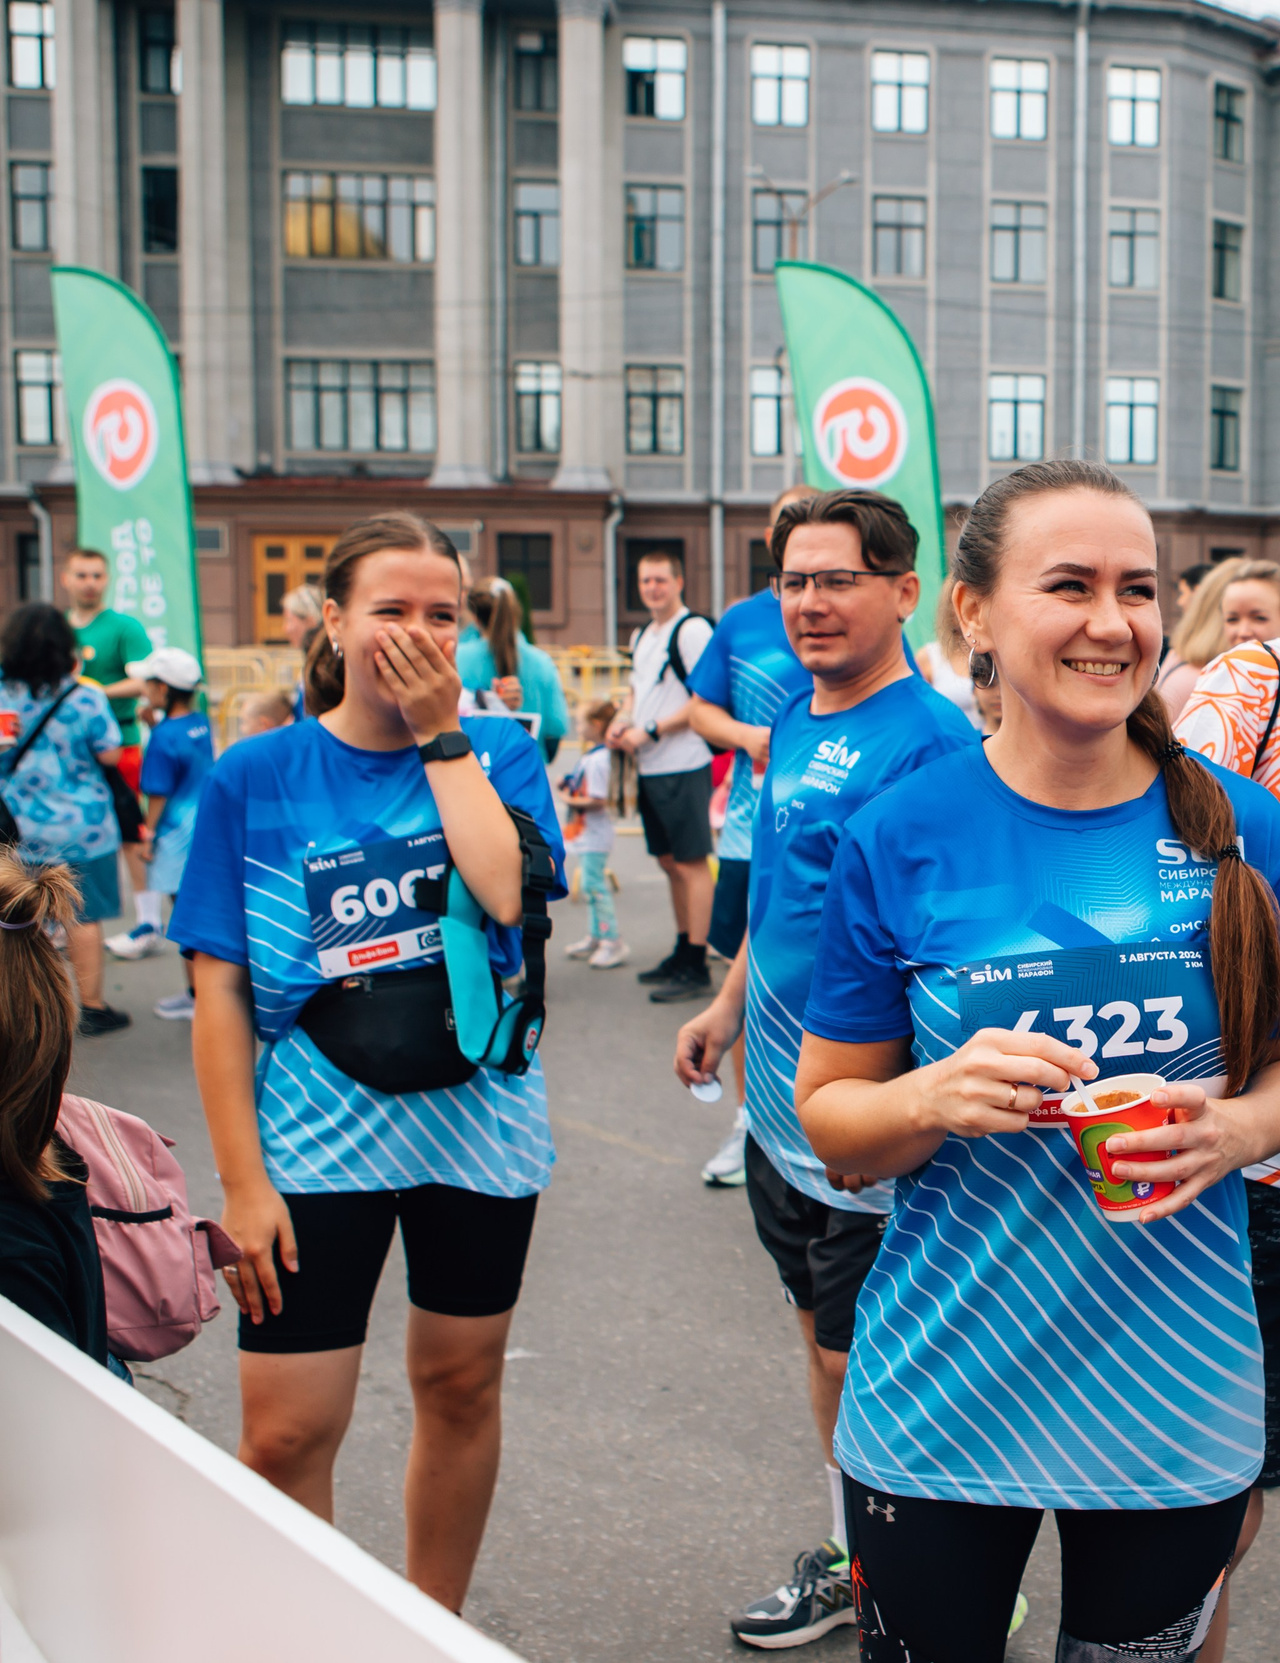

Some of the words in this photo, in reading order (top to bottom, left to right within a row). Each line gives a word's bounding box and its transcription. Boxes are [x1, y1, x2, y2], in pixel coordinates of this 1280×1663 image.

[1119, 954, 1126, 964] 3
[1128, 950, 1178, 963] АВГУСТА
[1178, 950, 1202, 960] 2024
[1018, 970, 1054, 979] МАРАФОН
